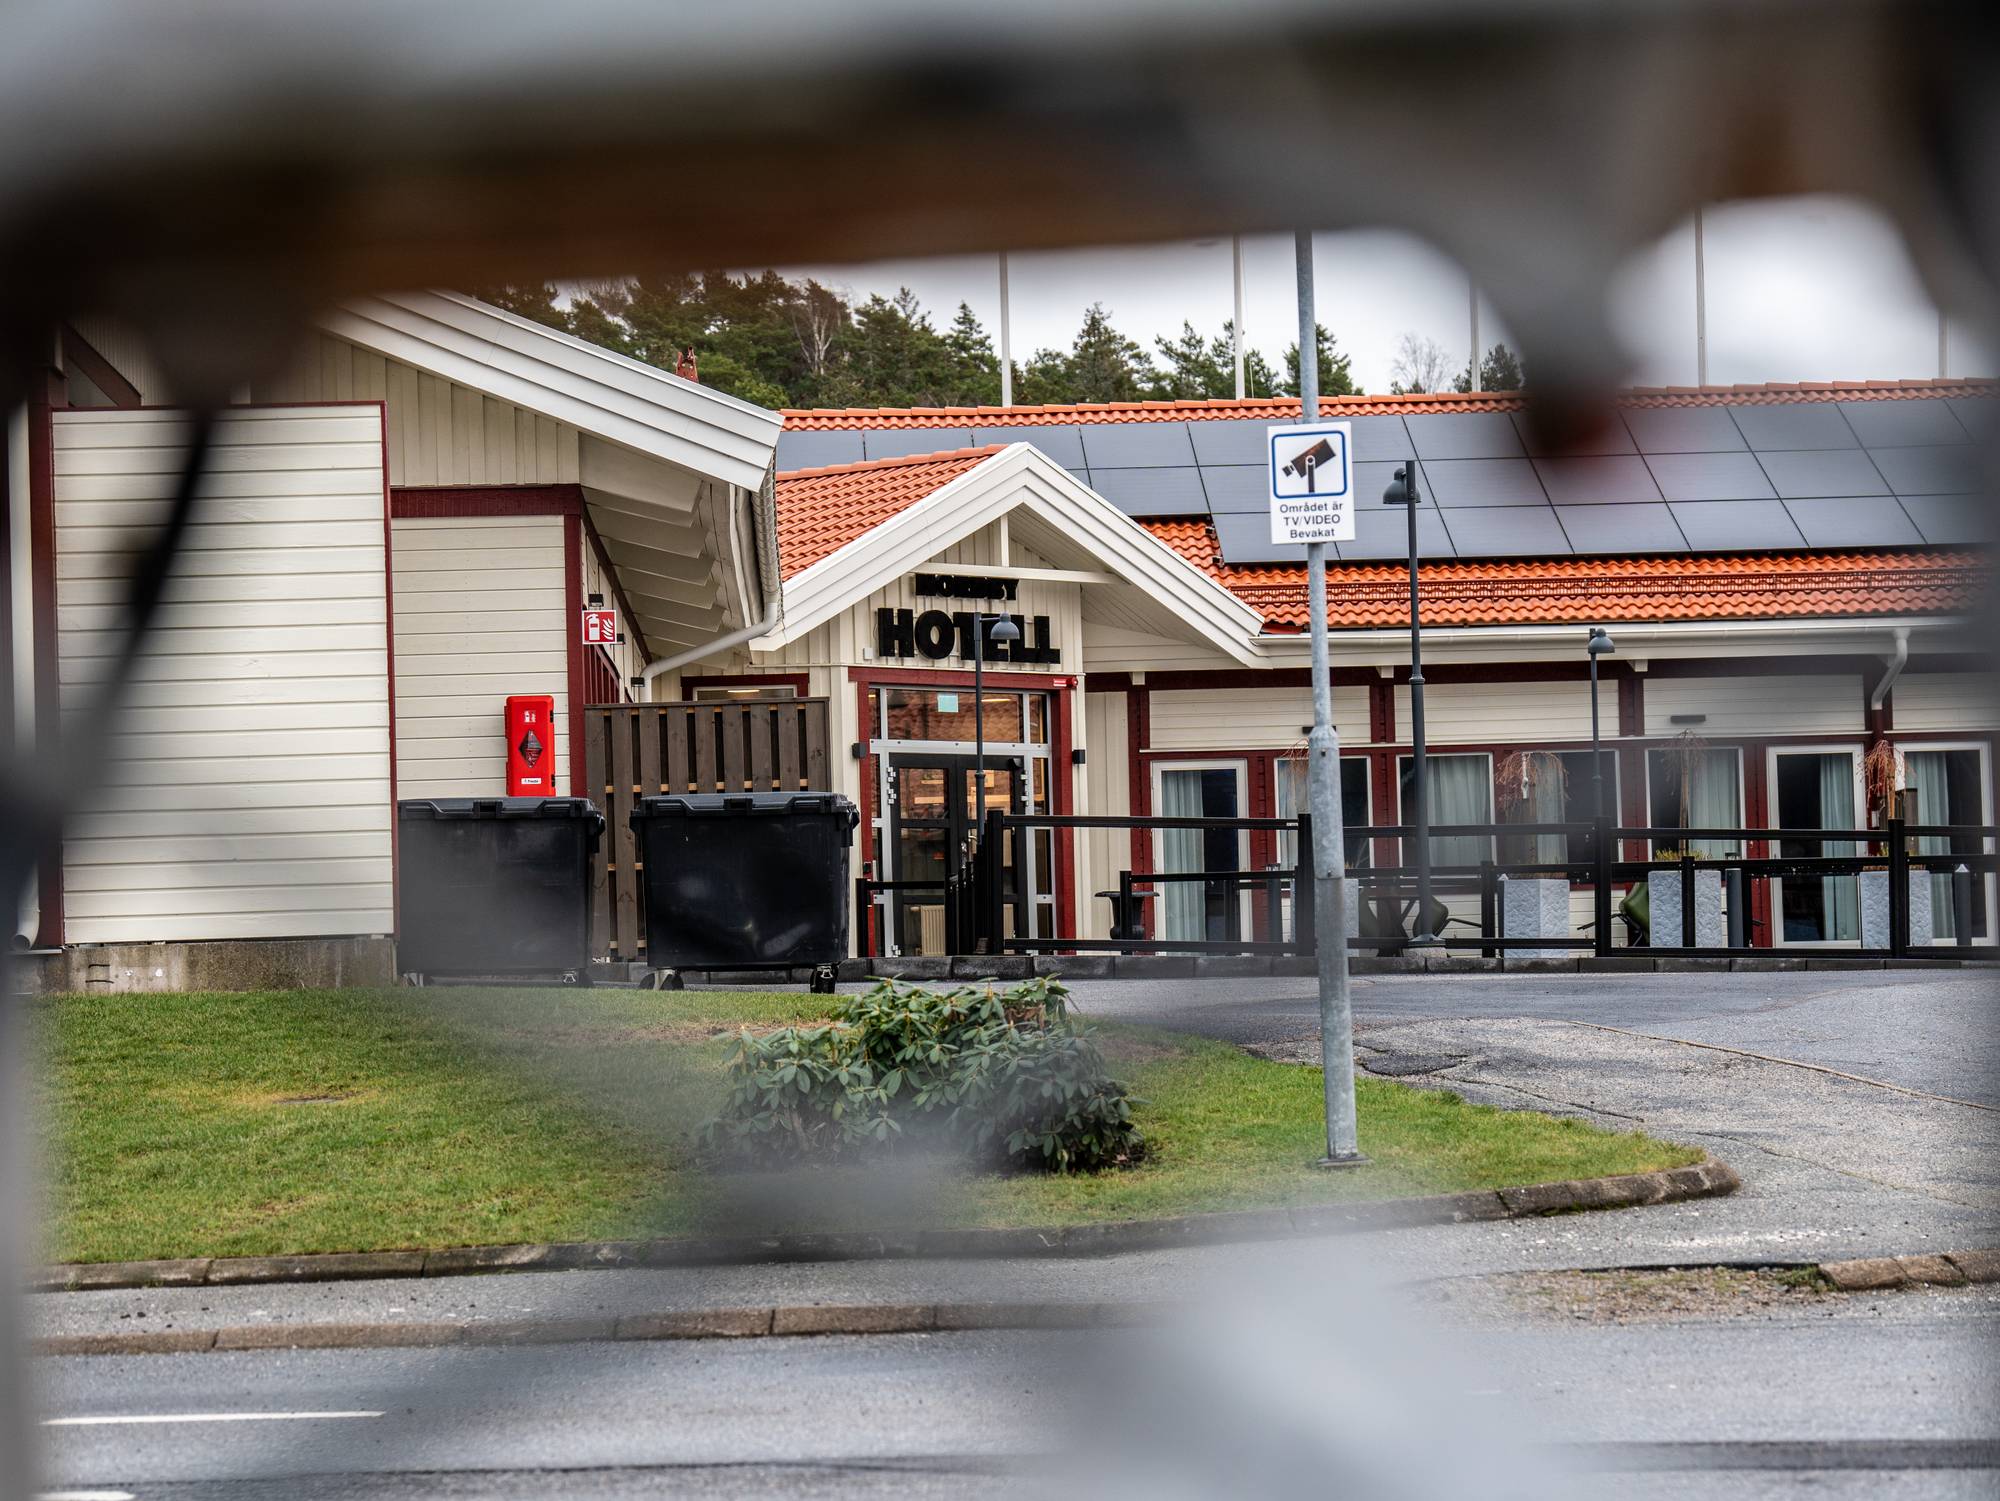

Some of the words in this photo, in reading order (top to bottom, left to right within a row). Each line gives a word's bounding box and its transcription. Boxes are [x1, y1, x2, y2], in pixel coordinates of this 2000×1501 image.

[1280, 502, 1328, 513] Området
[1332, 502, 1343, 511] är
[1283, 514, 1341, 526] TV/VIDEO
[1290, 528, 1335, 538] Bevakat
[877, 608, 1061, 664] HOTELL
